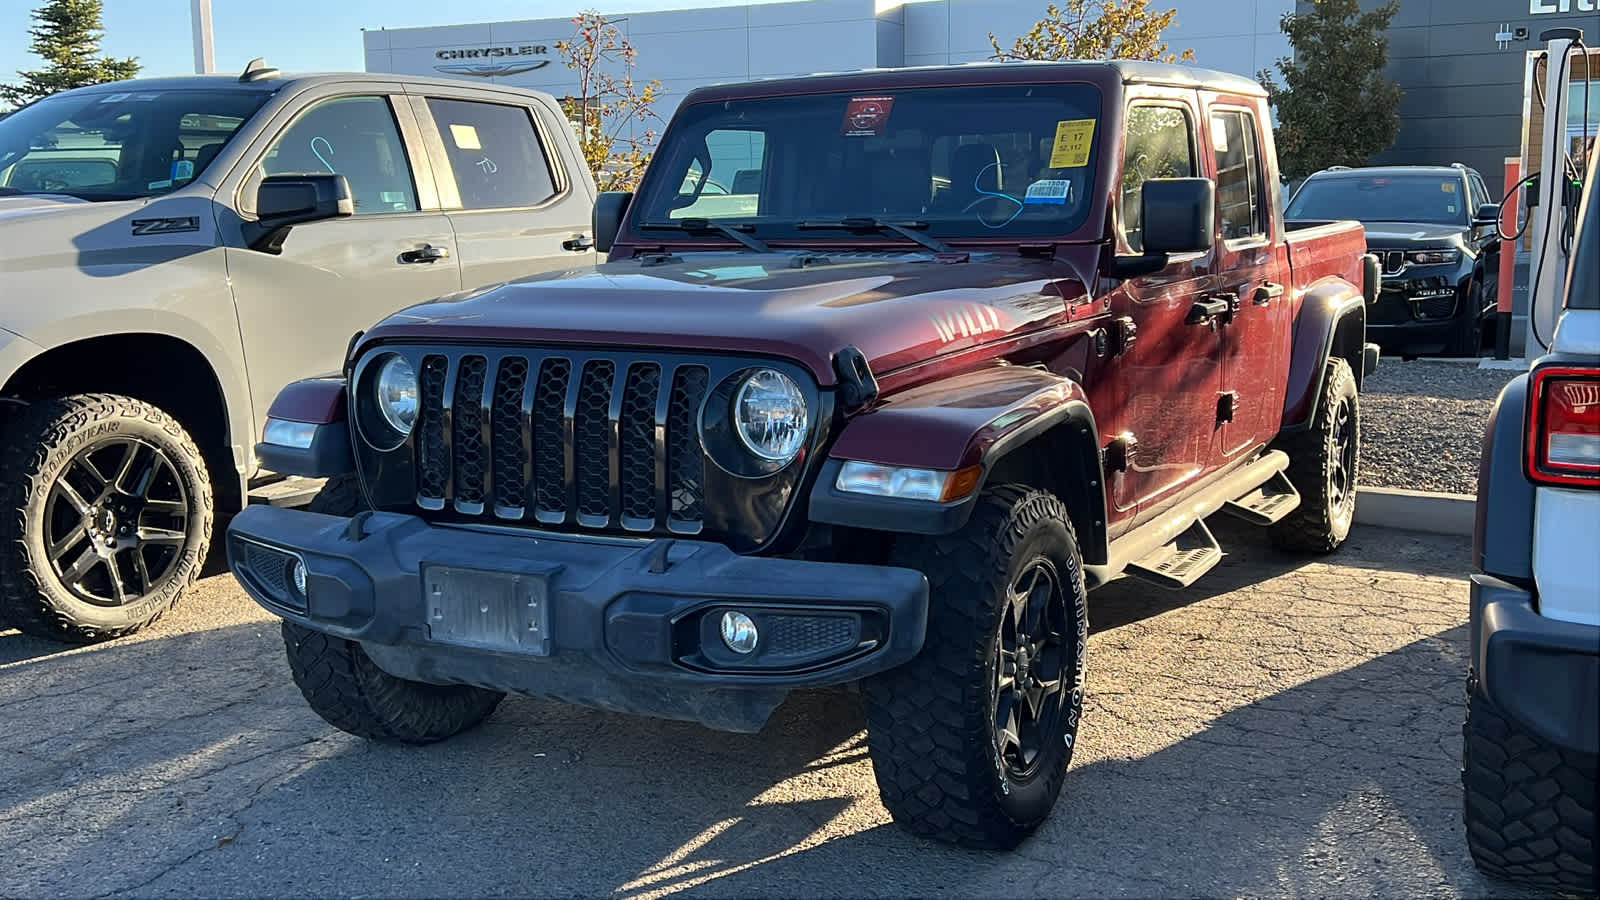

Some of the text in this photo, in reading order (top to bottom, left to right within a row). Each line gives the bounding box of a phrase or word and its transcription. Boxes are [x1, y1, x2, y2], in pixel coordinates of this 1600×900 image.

[436, 45, 548, 60] CHRYSLER
[1073, 132, 1084, 141] 17
[131, 216, 200, 236] Z71
[36, 420, 121, 498] GOODYEAR
[1065, 553, 1086, 728] DESTINATION
